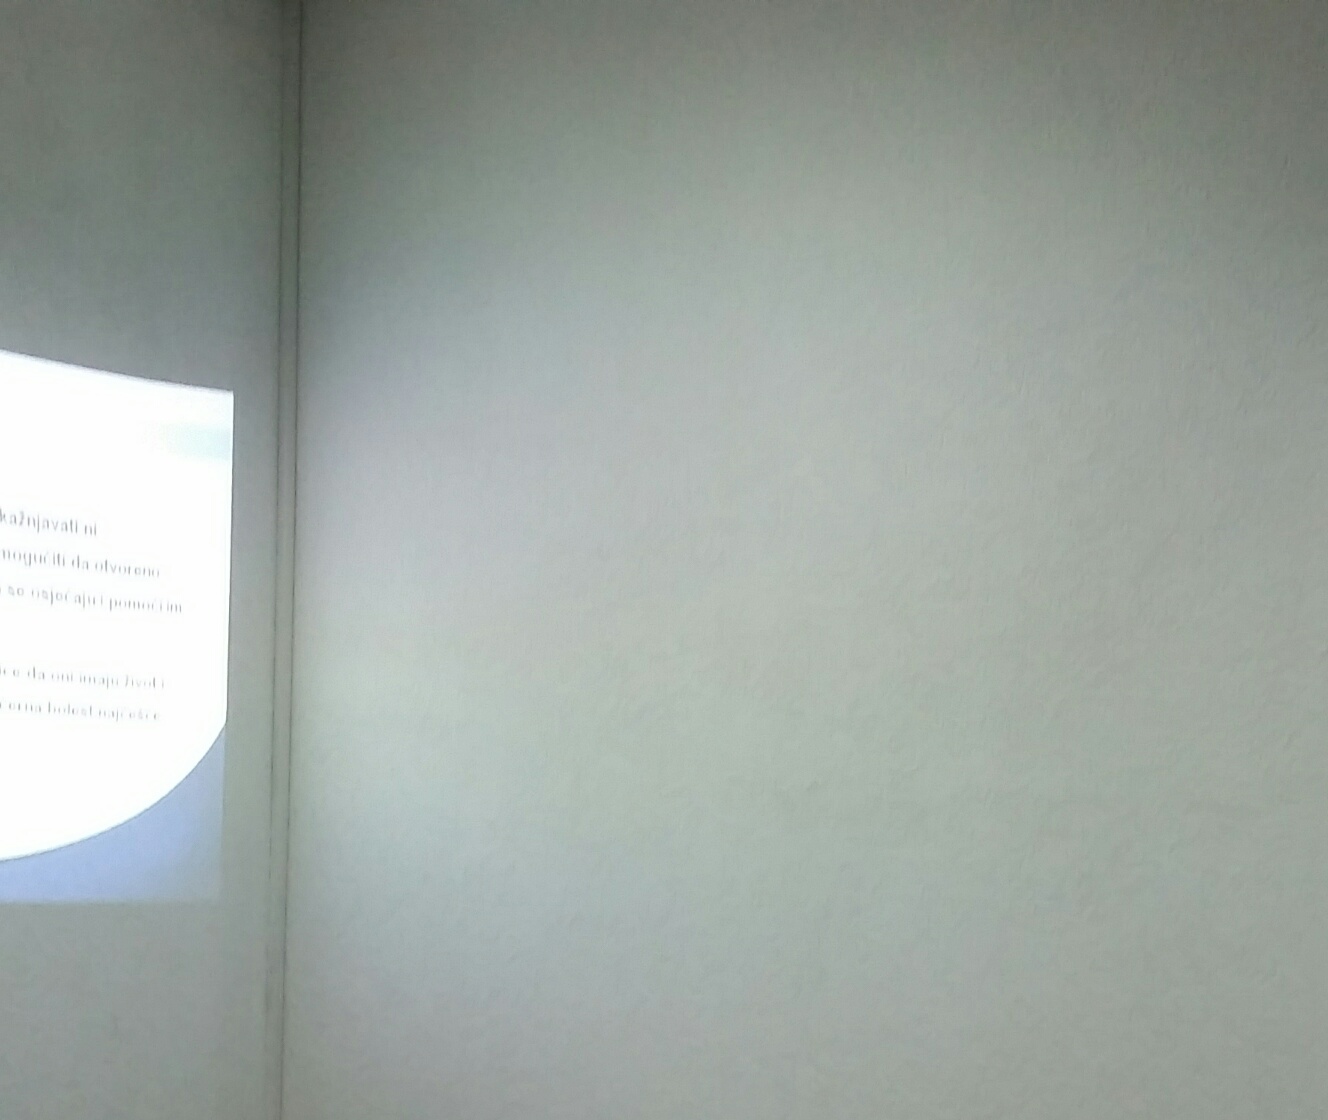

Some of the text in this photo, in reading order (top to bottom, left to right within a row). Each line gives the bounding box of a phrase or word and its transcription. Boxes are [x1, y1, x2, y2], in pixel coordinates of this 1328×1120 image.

[0, 506, 78, 534] kažnjavati
[84, 522, 97, 537] ni
[71, 555, 90, 571] da
[94, 559, 160, 578] otvoreno
